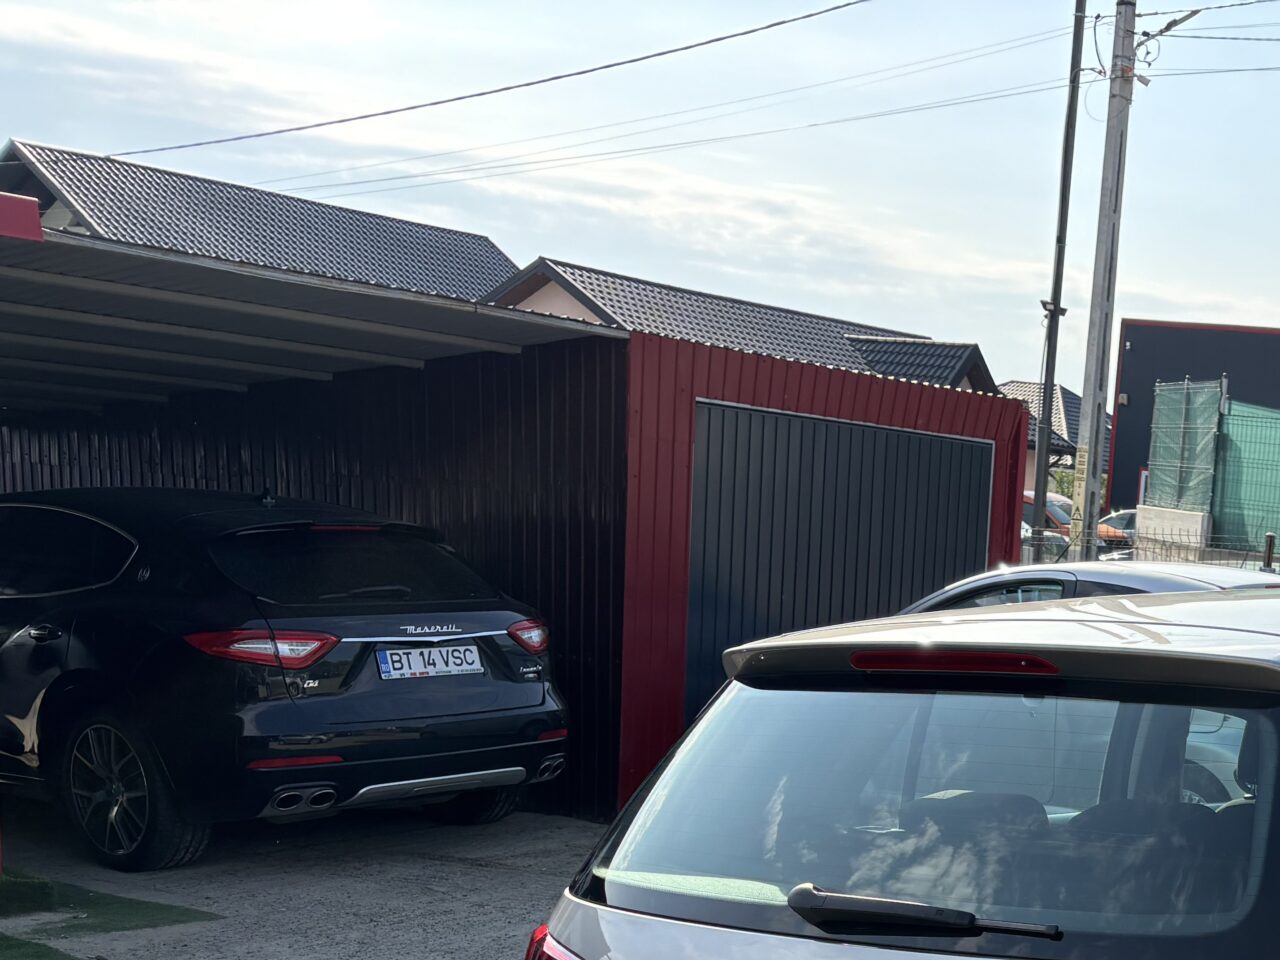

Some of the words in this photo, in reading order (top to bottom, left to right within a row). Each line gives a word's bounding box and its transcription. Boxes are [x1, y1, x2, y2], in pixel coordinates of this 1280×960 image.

[389, 651, 413, 671] BT
[418, 650, 437, 669] 14
[438, 648, 475, 668] VSC
